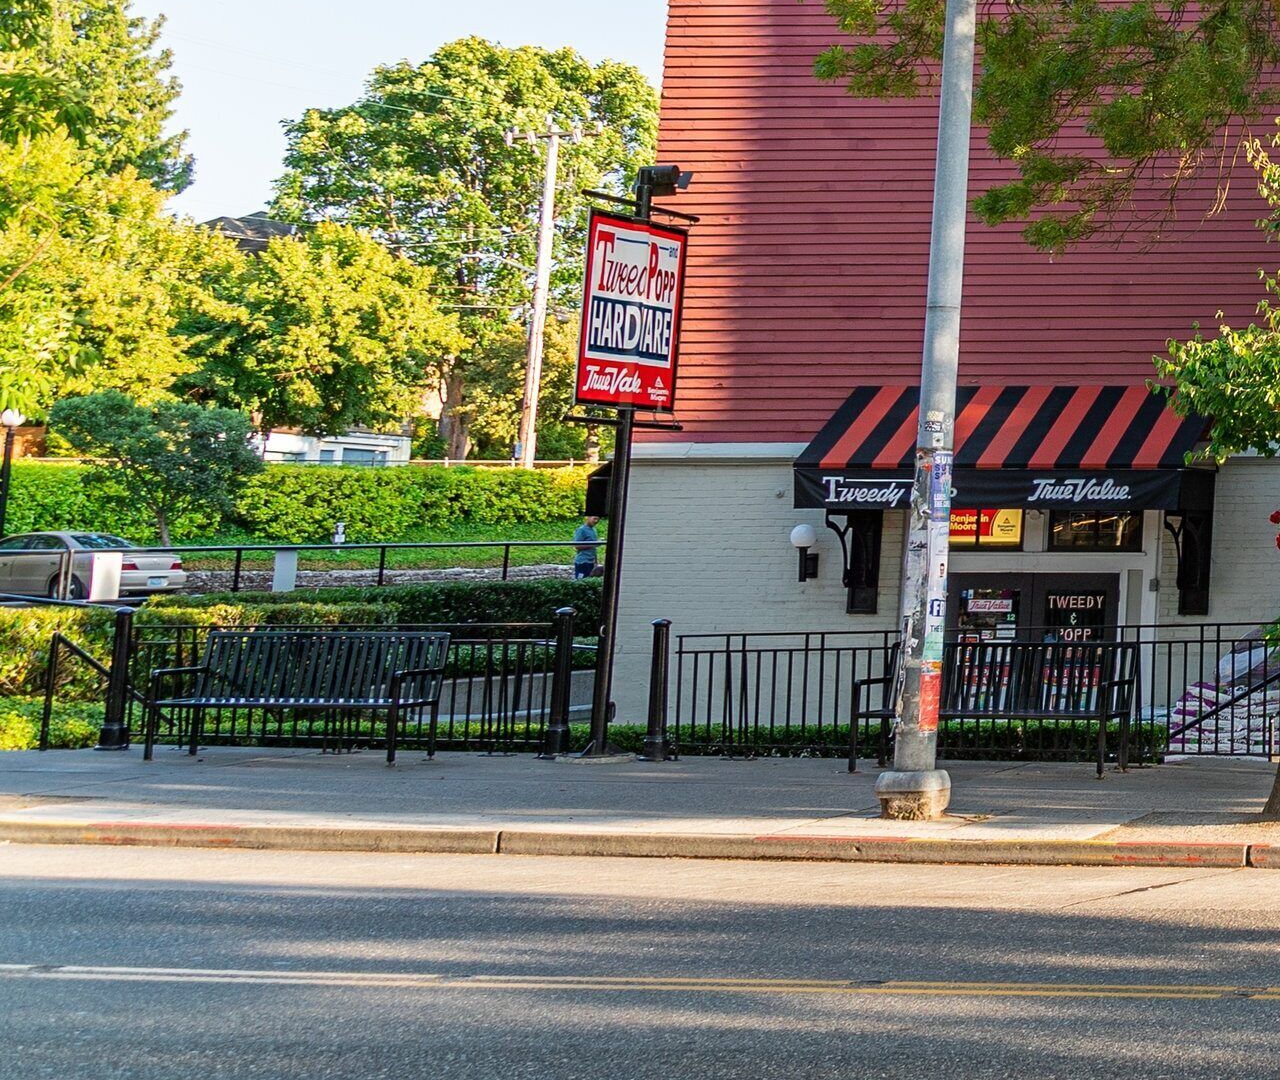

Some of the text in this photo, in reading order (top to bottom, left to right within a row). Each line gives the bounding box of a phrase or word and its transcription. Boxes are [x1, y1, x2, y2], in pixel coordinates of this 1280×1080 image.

[590, 299, 672, 356] HARDARE
[822, 476, 907, 506] Tweedy
[950, 522, 977, 531] Moore
[1048, 595, 1104, 608] TWEEDY
[1007, 613, 1016, 621] 12
[1060, 628, 1092, 642] OPP
